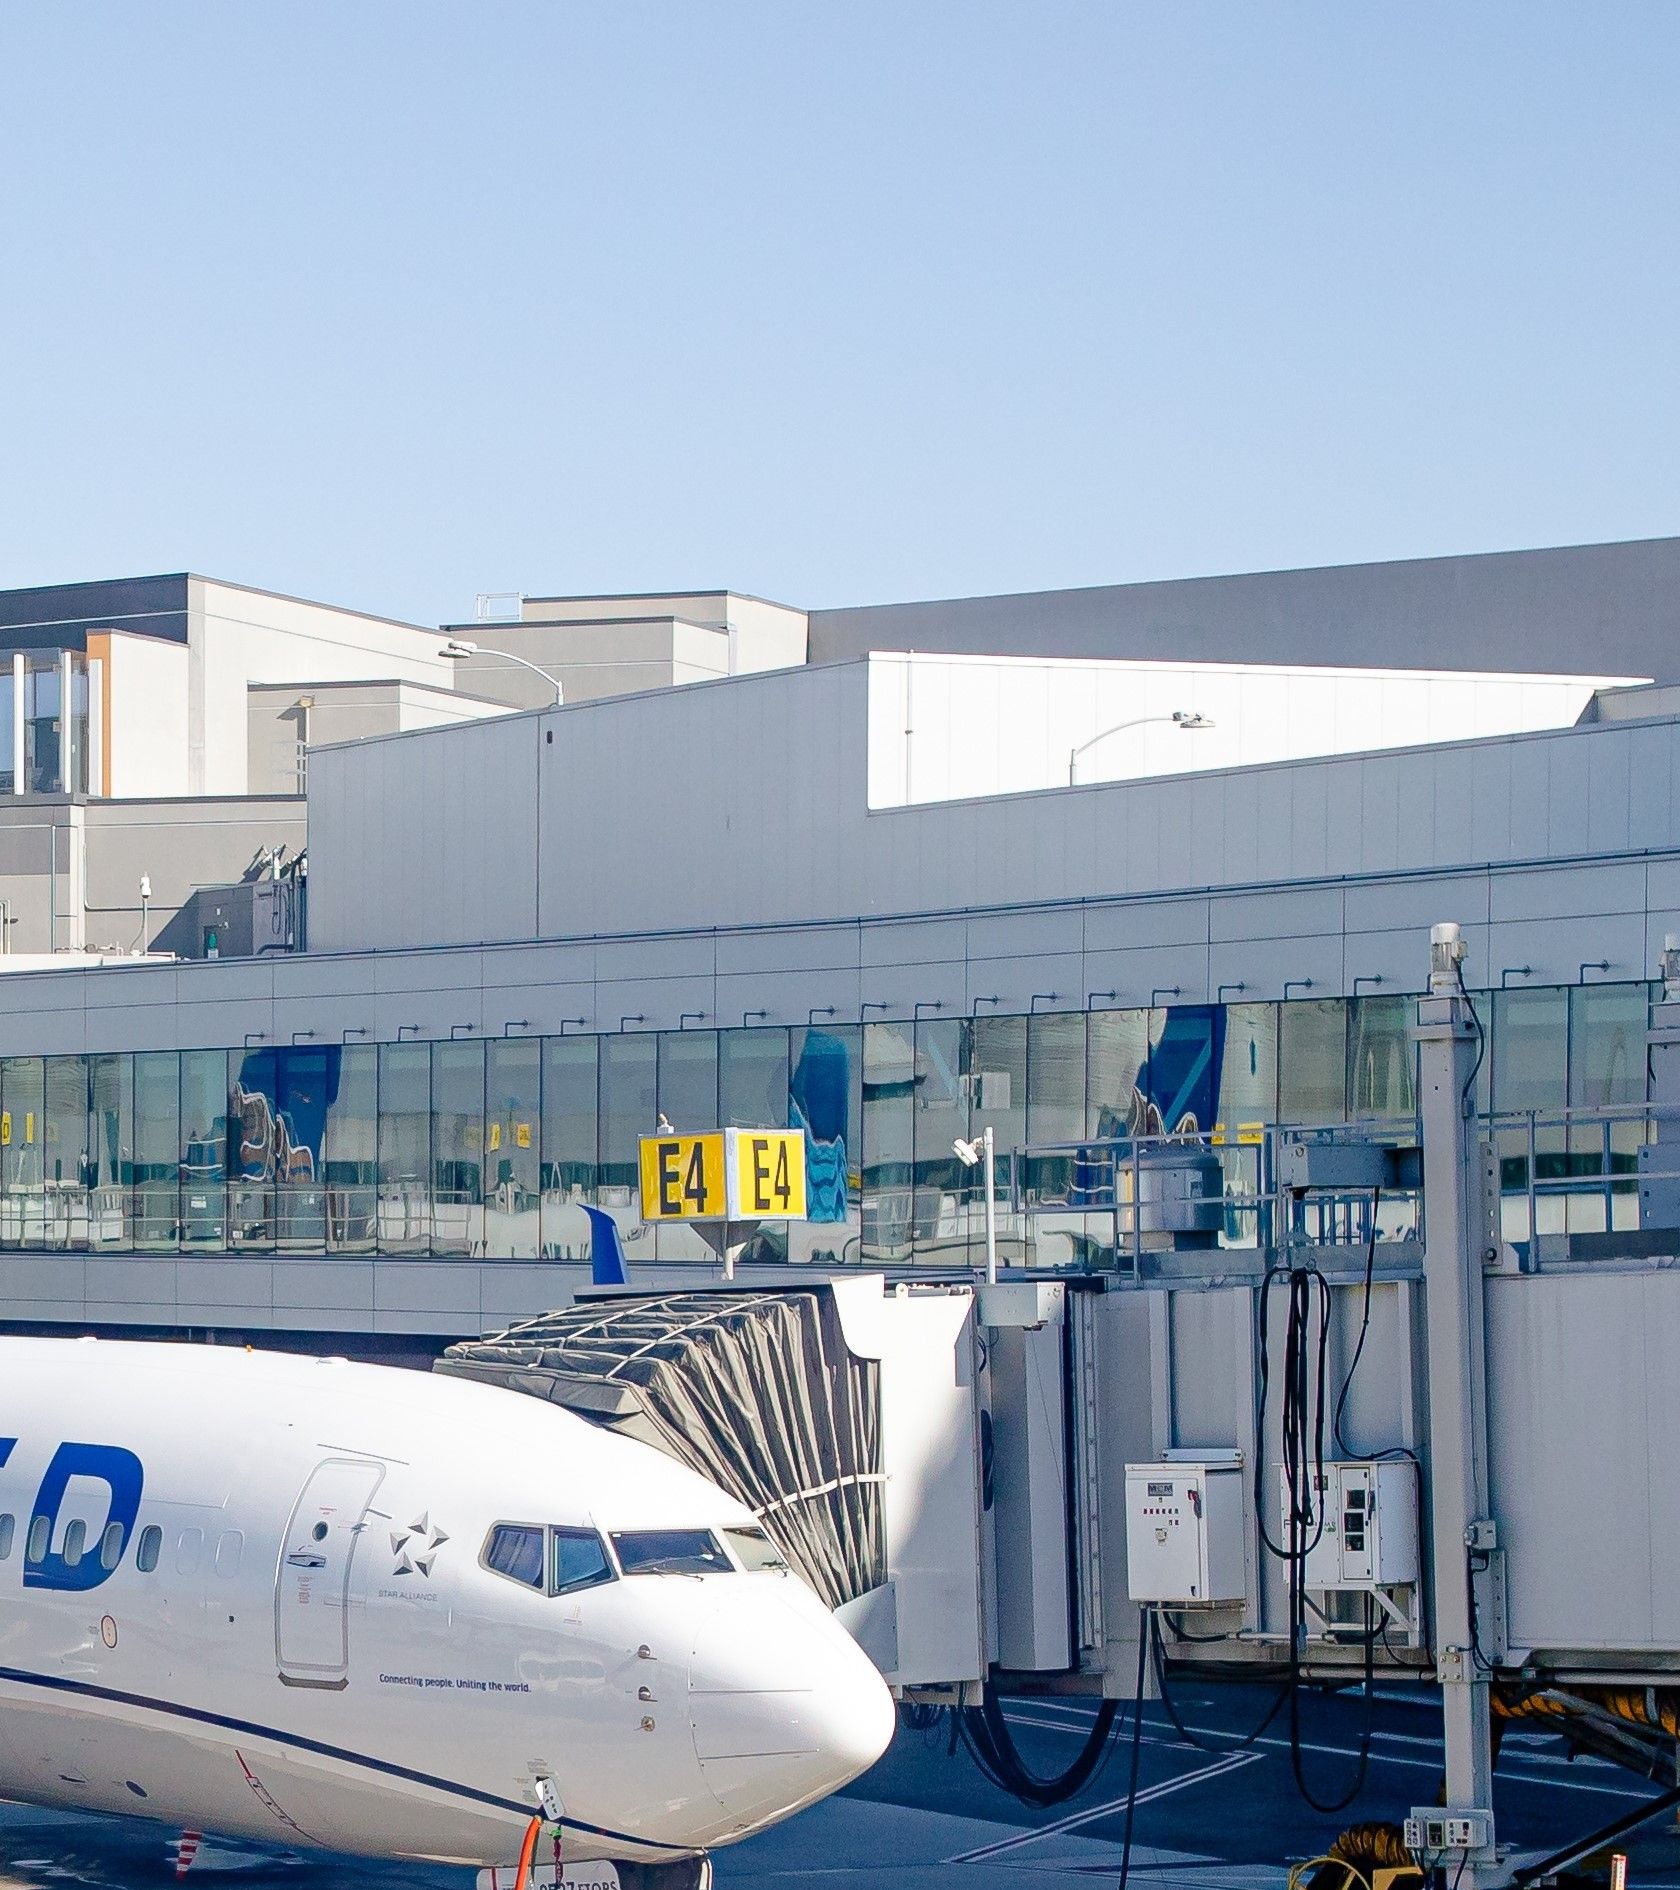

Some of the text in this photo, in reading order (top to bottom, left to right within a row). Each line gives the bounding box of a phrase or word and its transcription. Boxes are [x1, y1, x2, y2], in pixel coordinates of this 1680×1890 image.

[658, 1141, 708, 1215] E4
[752, 1139, 791, 1210] E4
[378, 1589, 439, 1602] STAR ALLIANCE
[379, 1673, 532, 1693] Connecting people. Uniting the world.
